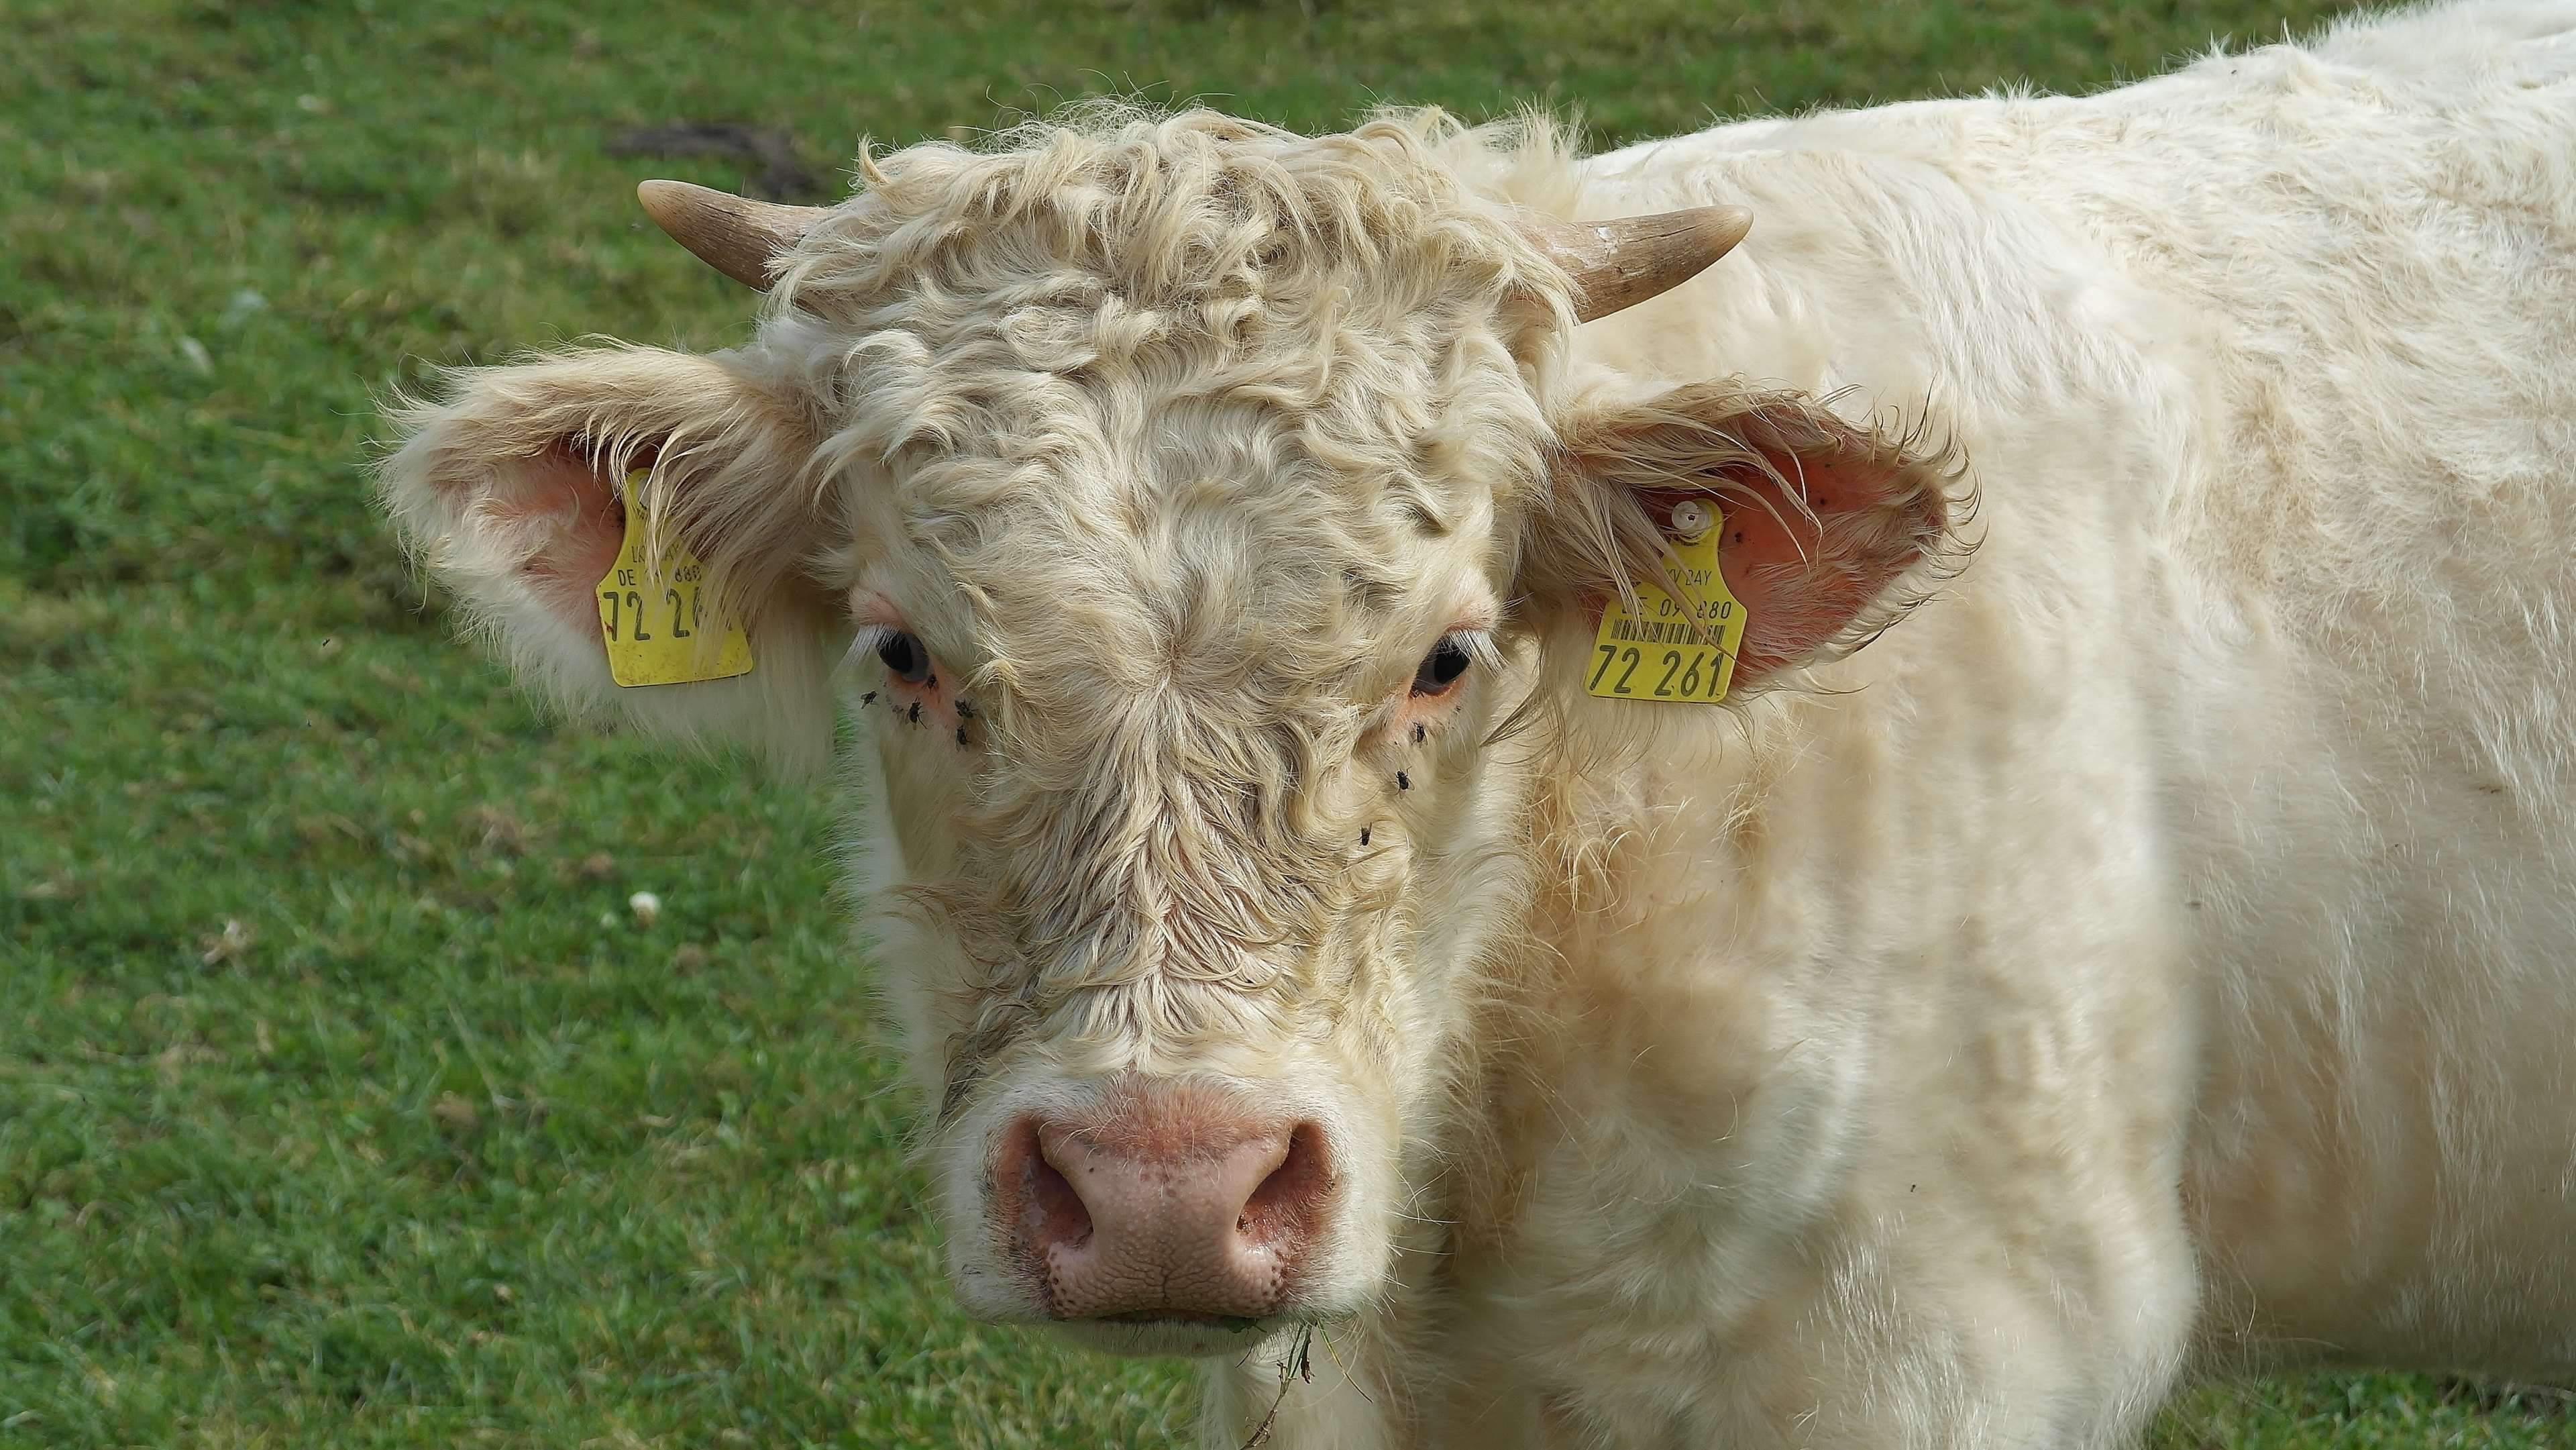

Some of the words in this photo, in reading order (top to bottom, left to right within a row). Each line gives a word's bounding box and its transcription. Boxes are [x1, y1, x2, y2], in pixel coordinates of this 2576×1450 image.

[618, 569, 636, 586] DE
[603, 591, 650, 641] 72
[1697, 600, 1731, 619] 880
[1589, 644, 1640, 694] 72
[1654, 650, 1723, 698] 261
